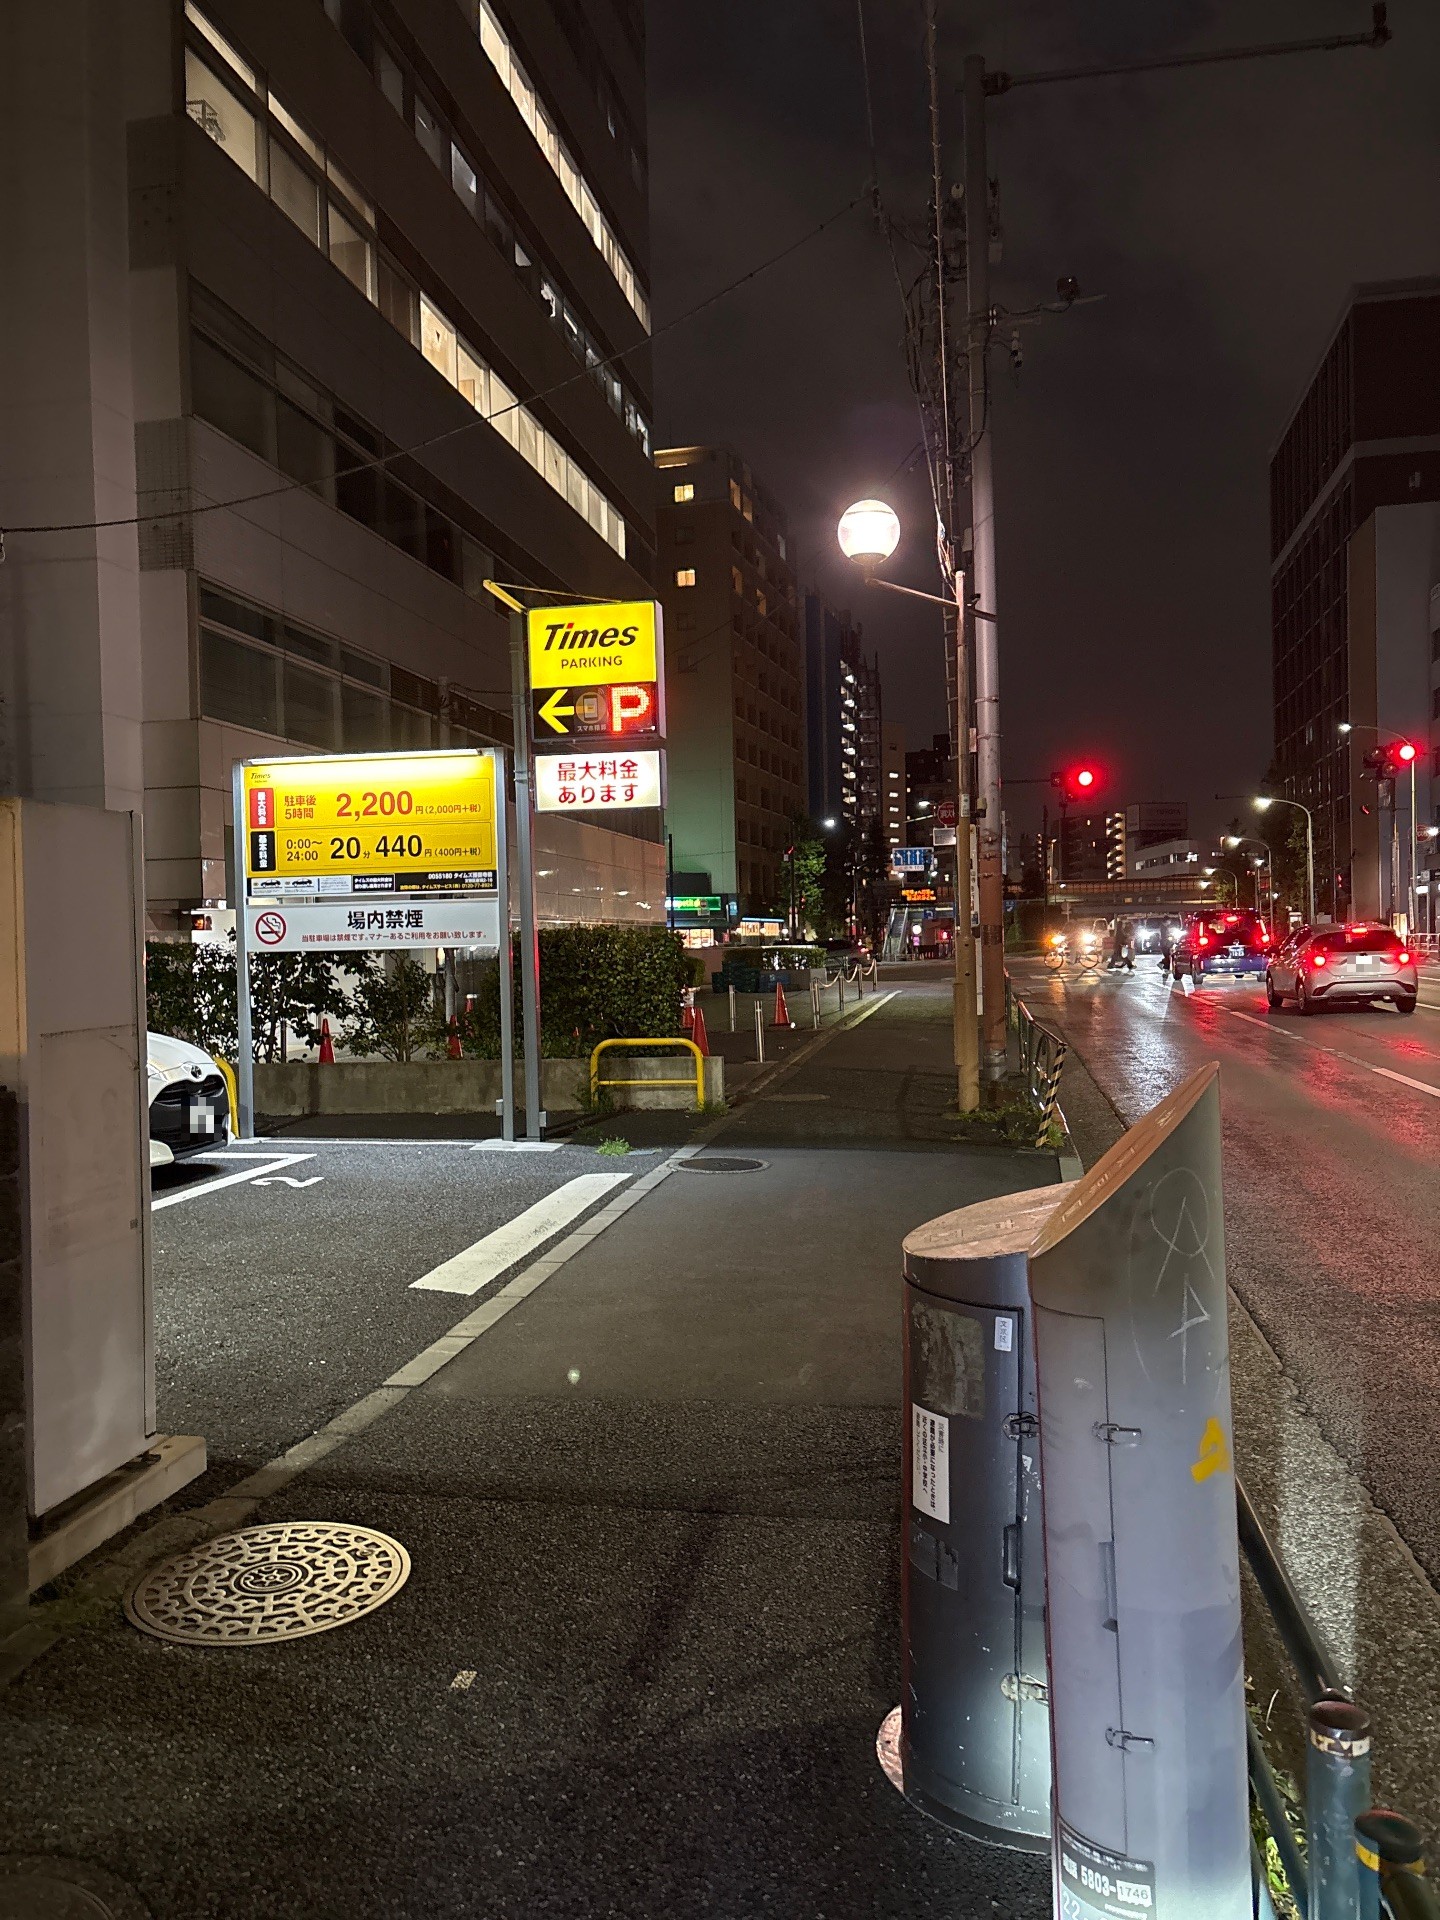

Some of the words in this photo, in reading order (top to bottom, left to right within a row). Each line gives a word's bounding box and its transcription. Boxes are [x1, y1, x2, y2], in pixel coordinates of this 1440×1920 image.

[544, 623, 639, 651] Times
[561, 655, 622, 670] PARKING
[610, 685, 650, 733] P
[250, 772, 271, 780] Times
[557, 759, 639, 782] 最大料金
[284, 795, 316, 807] 駐車後
[558, 783, 638, 804] あります
[284, 808, 314, 820] 5時間
[286, 850, 319, 862] 24:00
[347, 910, 424, 929] 場内禁煙
[999, 1320, 1008, 1343] 文京区
